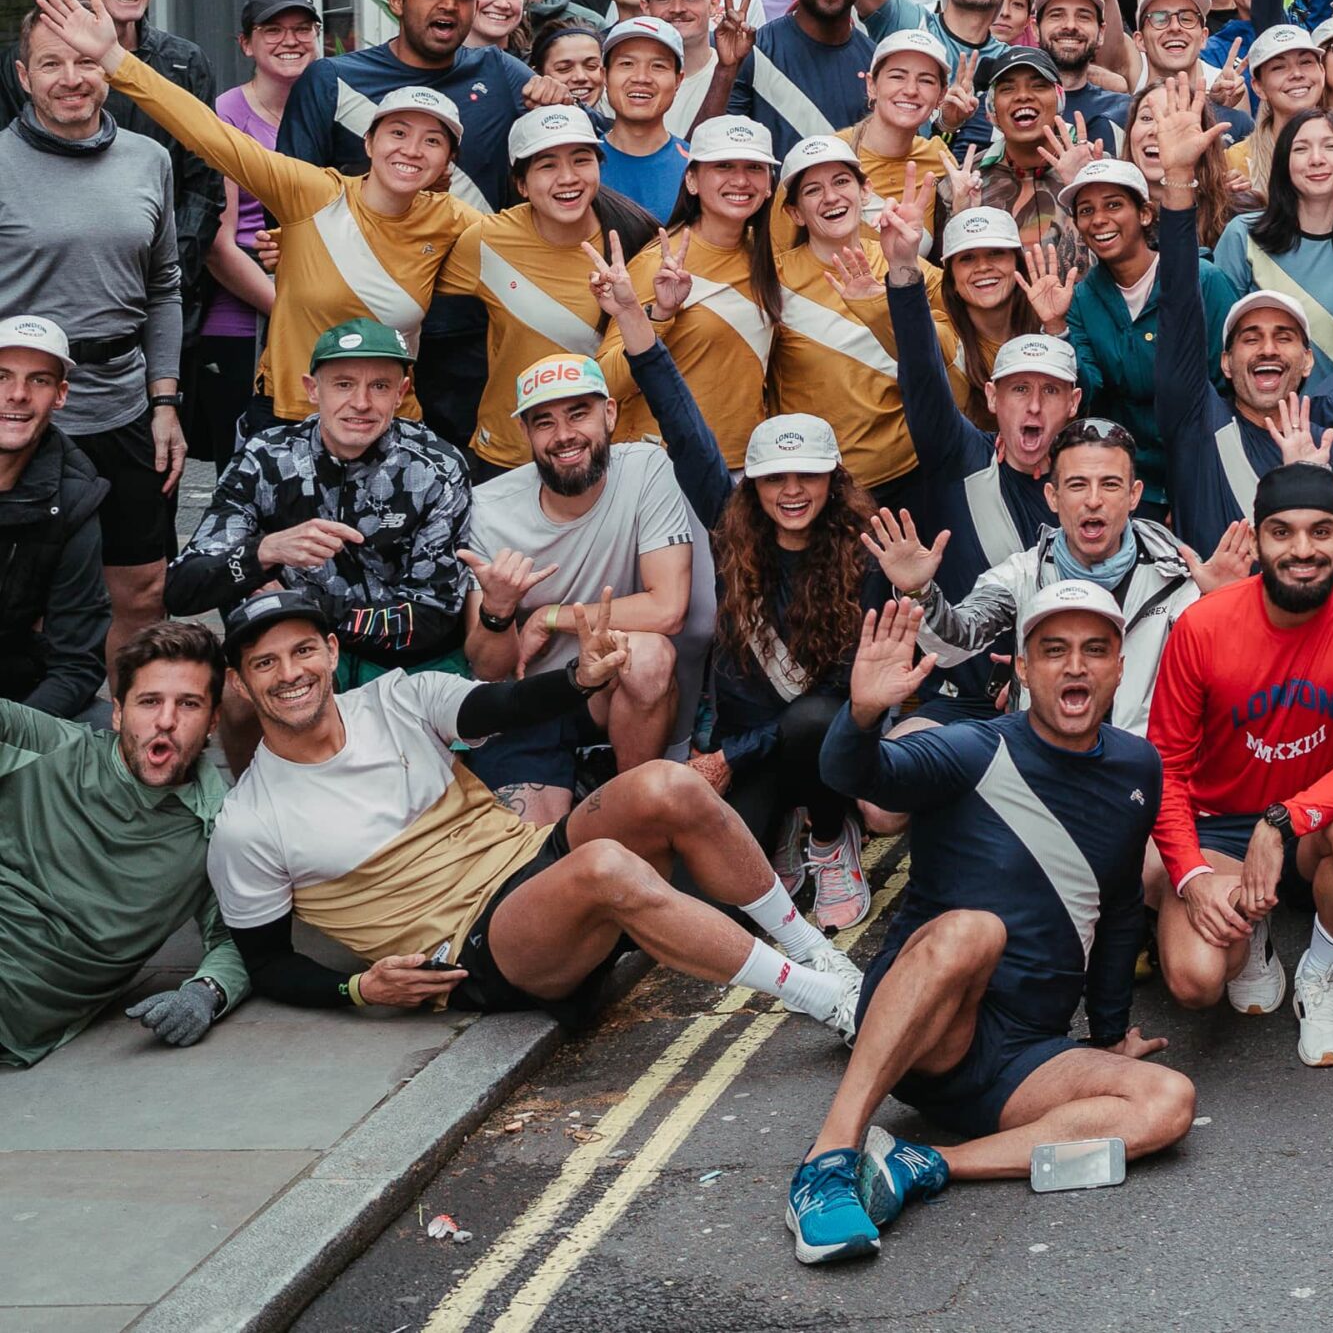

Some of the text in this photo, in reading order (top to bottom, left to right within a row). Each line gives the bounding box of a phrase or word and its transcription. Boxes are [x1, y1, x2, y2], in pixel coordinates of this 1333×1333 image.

[411, 92, 440, 105] LONDON
[540, 113, 569, 126] LONDON
[726, 125, 754, 137] LONDON
[802, 140, 829, 153] LONDON
[962, 216, 990, 230] LONDON
[15, 322, 48, 334] LONDON
[1020, 342, 1049, 352] LONDON
[522, 363, 581, 397] ciele
[775, 432, 805, 445] LONDON
[1056, 586, 1089, 597] LONDON
